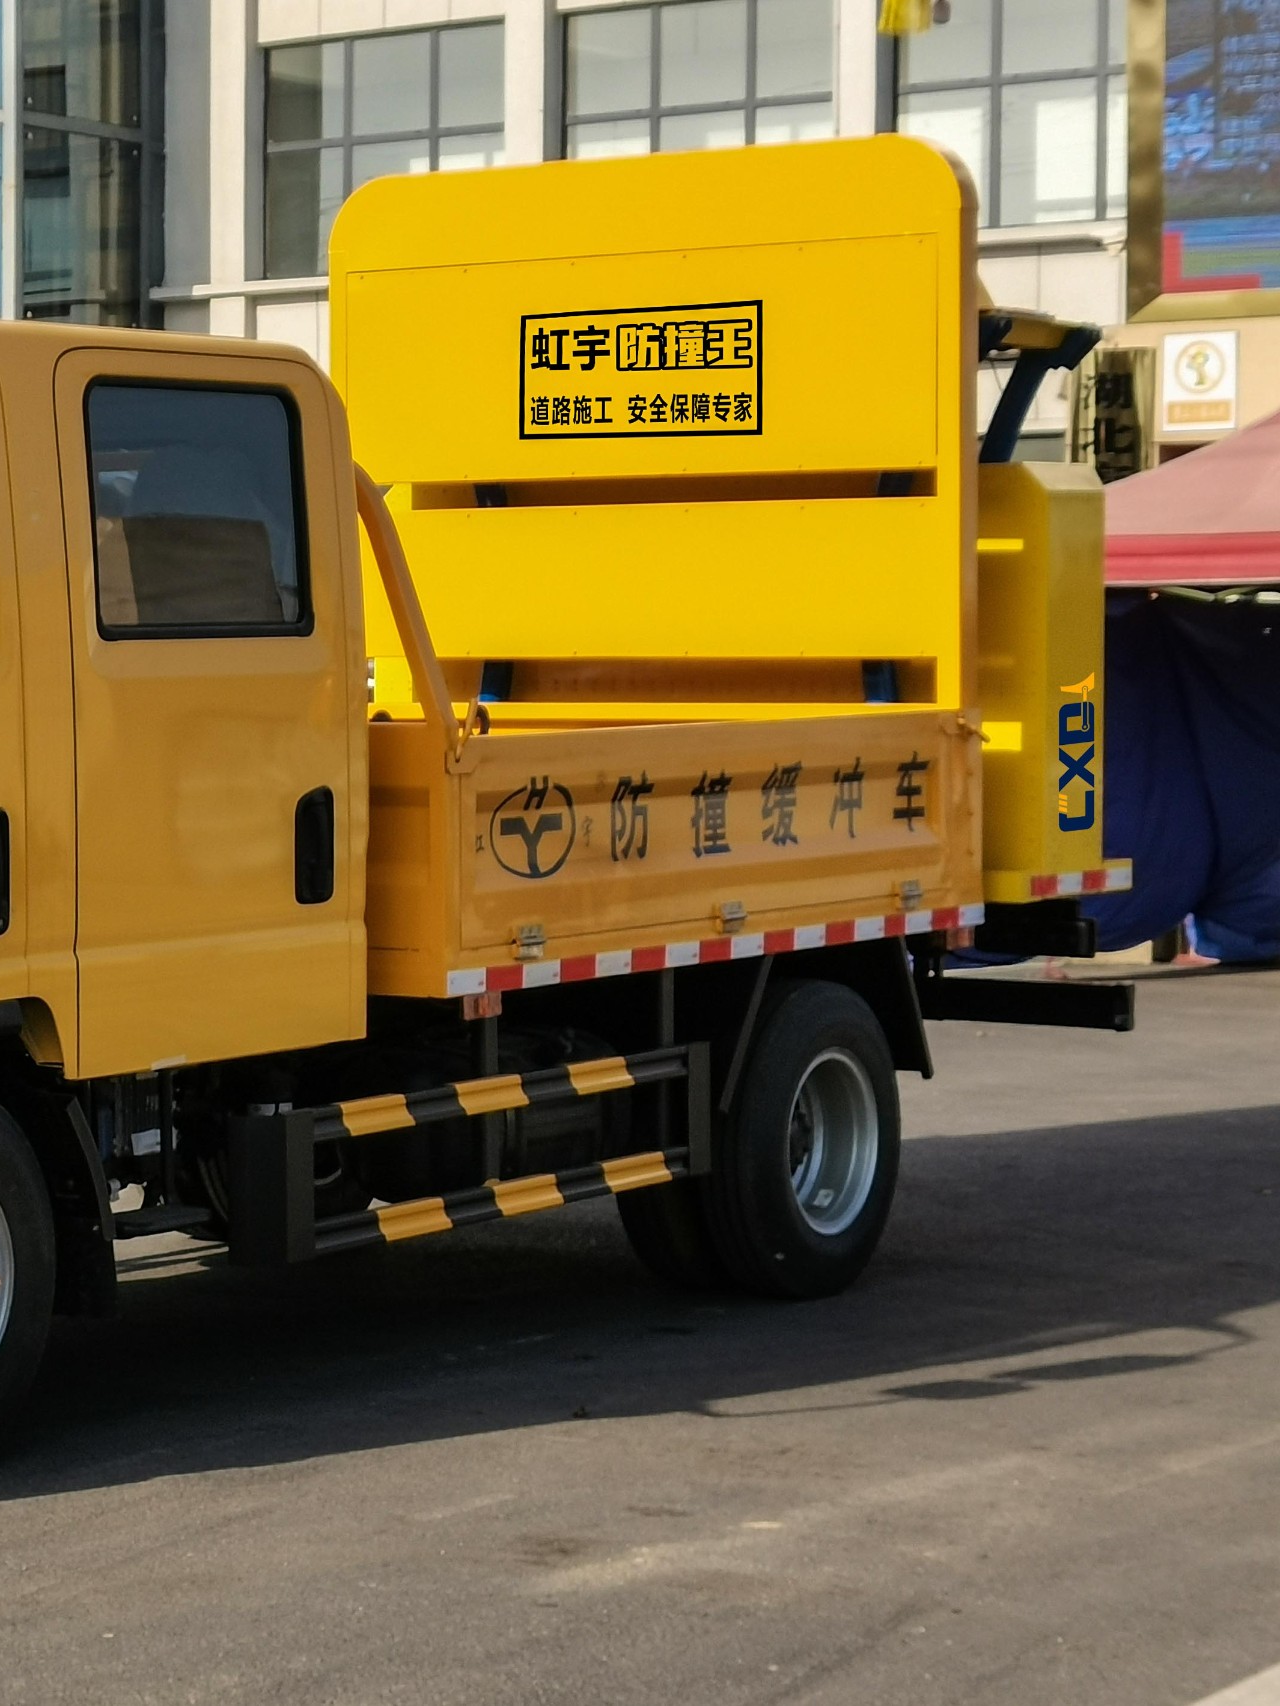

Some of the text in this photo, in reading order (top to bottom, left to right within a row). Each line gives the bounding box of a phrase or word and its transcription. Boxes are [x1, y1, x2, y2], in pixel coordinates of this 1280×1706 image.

[531, 392, 753, 426] 道路施工 安全保障专家
[611, 751, 930, 862] 防撞缓冲车
